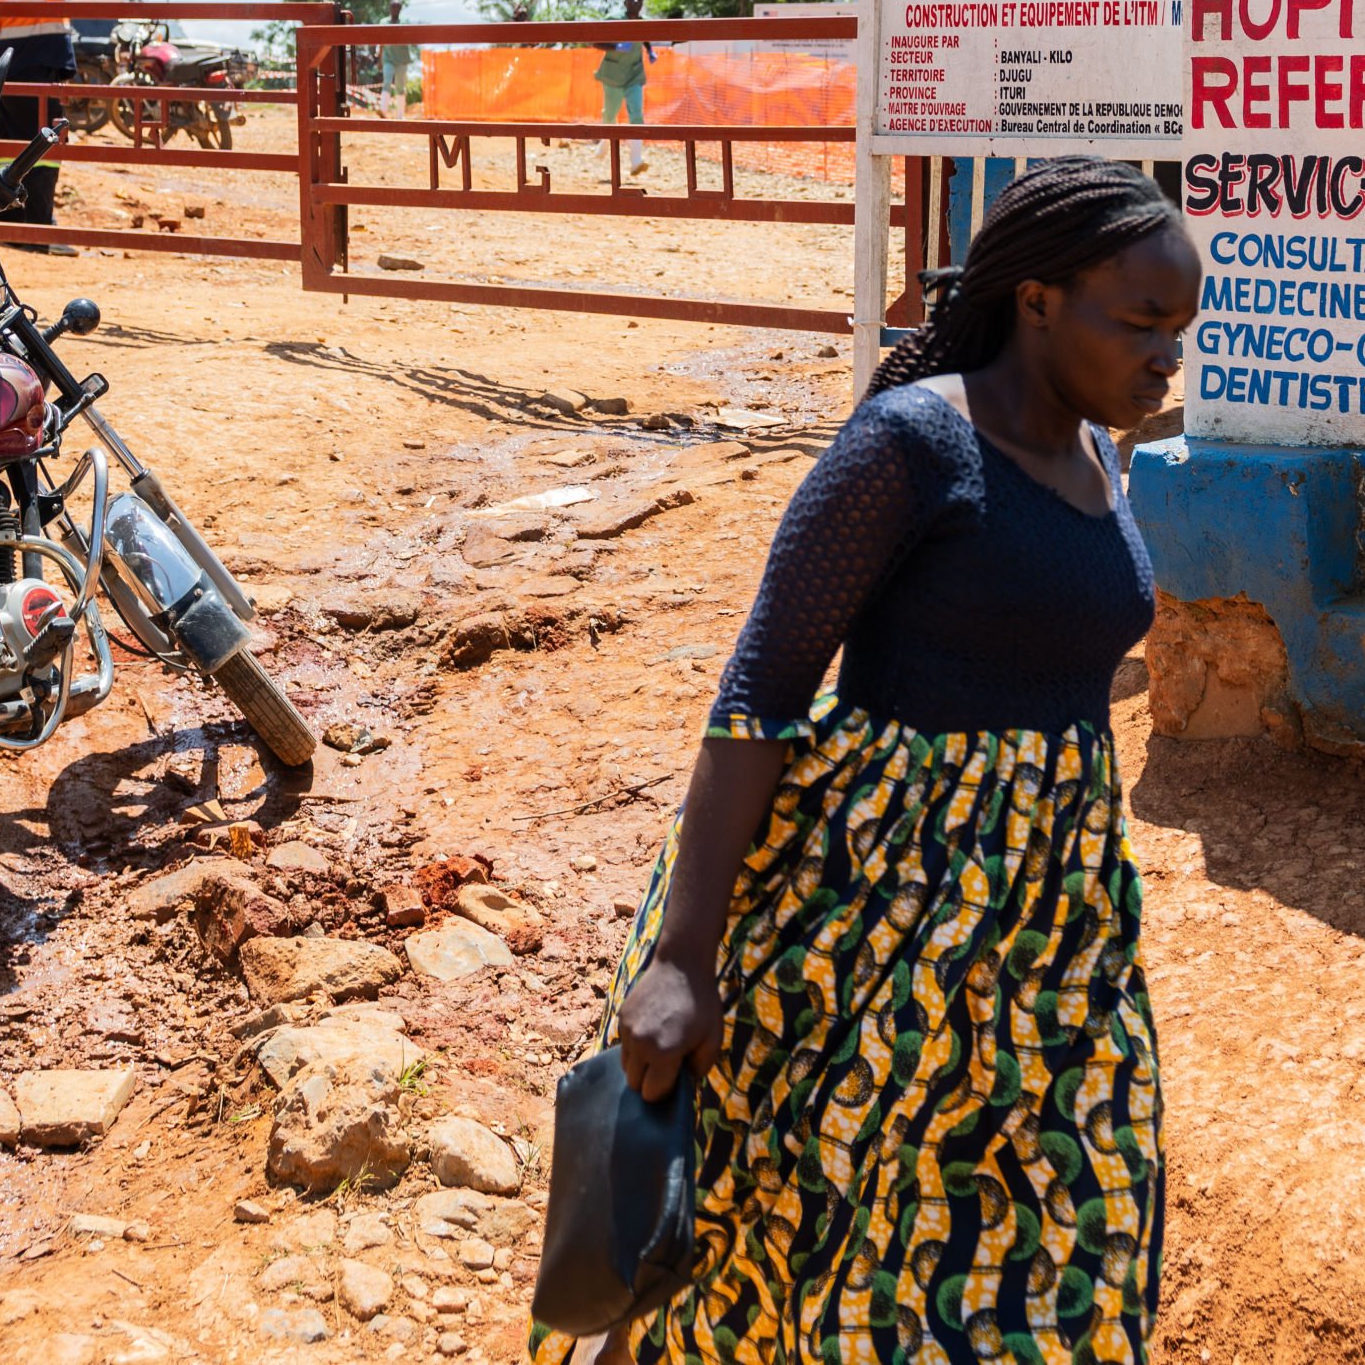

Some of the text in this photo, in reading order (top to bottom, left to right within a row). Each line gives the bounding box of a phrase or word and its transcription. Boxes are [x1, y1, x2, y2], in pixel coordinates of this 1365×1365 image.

[905, 3, 998, 28] CONSTRUCTION
[1001, 2, 1017, 27] ET
[1020, 1, 1100, 28] EQUIPEMENT
[1103, 1, 1120, 26] DE
[1124, 0, 1158, 26] L'ITM
[891, 35, 939, 49] INAUGURE
[941, 35, 960, 49] PAR
[890, 51, 934, 64] SECTEUR
[1001, 50, 1042, 64] BANYALI
[1049, 50, 1073, 64] KILO
[890, 69, 945, 82] TERRITOIRE
[999, 69, 1032, 83] DJUGU
[889, 86, 937, 100] PROVINCE
[999, 86, 1026, 100] ITURI
[888, 102, 919, 115] MAITRE
[920, 102, 966, 116] D'OUVRAGE
[999, 102, 1067, 116] GOUVERNEMENT
[1069, 103, 1081, 116] DE
[1082, 102, 1094, 117] LA
[1095, 103, 1152, 117] REPUBLIQUE
[888, 118, 927, 132] AGENCE
[929, 119, 992, 133] D'EXECUTION
[1001, 119, 1034, 133] Bureau
[1036, 119, 1071, 133] Central
[1073, 120, 1085, 133] de
[1087, 119, 1152, 135] Coordination
